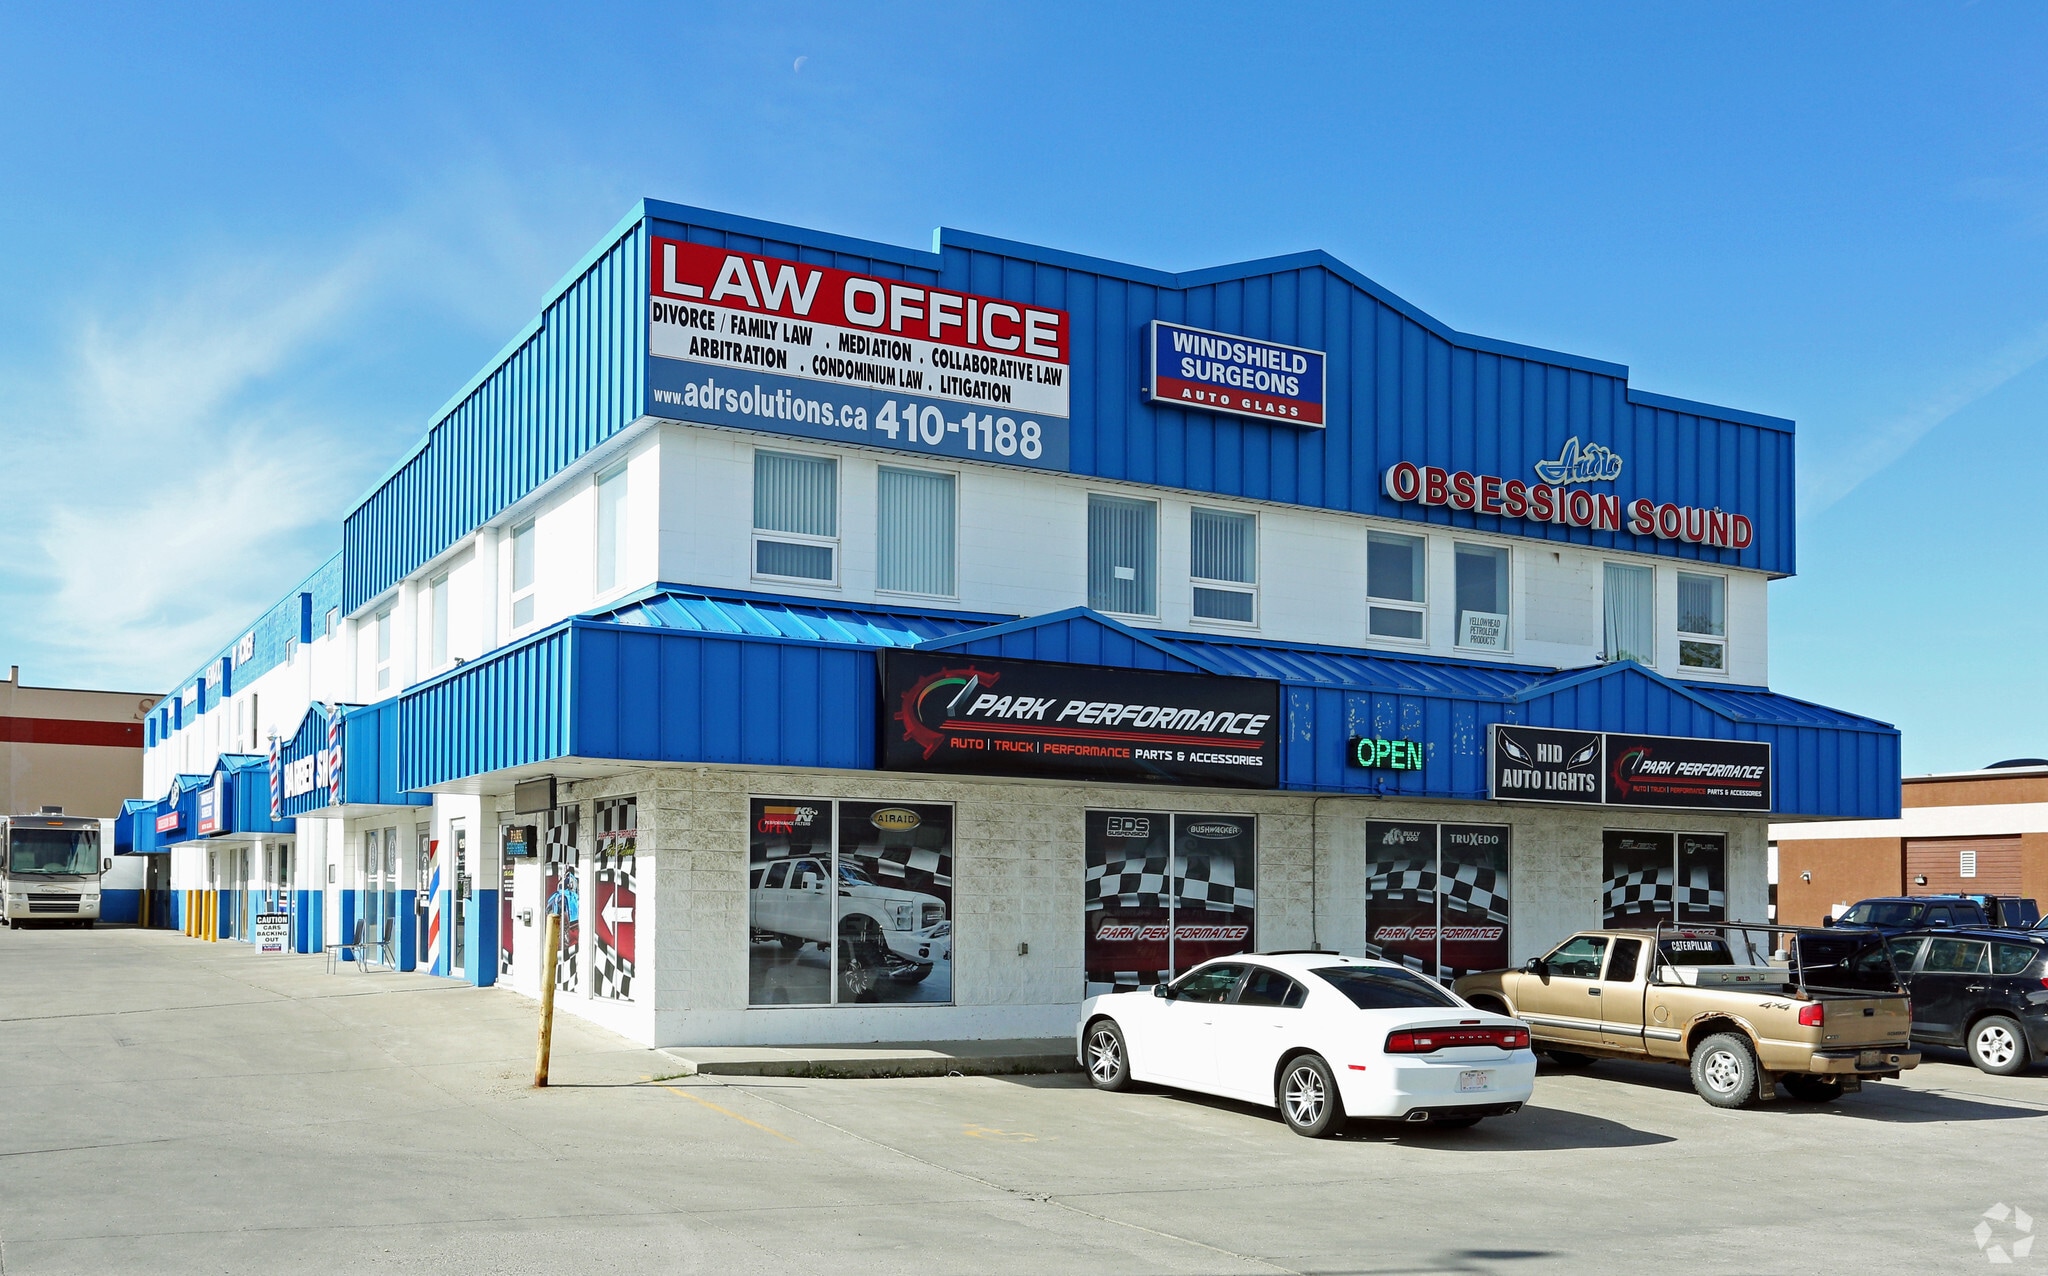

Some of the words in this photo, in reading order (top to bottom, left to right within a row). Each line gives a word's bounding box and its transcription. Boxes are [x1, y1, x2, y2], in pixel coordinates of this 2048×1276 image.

[663, 243, 823, 316] LAW
[843, 277, 1060, 359] OFFICE
[653, 302, 715, 331] DIVORCE
[731, 315, 778, 341] FAMILY
[784, 324, 813, 346] LAW
[839, 333, 912, 363] MEDIATION
[932, 348, 1033, 381] COLLABORATIVE
[1037, 365, 1062, 386] LAW
[1172, 331, 1307, 374] WINDSHIELD
[689, 336, 787, 369] ARBITRATION
[812, 355, 896, 386] CONDOMINIUM
[899, 368, 923, 391] LAW
[941, 375, 1011, 403] LITIGATION
[1181, 357, 1299, 396] SURGEONS
[1182, 388, 1230, 405] AUTO
[1241, 399, 1298, 416] GLASS
[653, 378, 867, 430] www.adrsolutions.ca
[875, 400, 1042, 460] 410-1188
[1386, 461, 1620, 531] OBSESSION
[1628, 498, 1753, 549] SOUND
[1469, 617, 1501, 627] YELLOWHEAD
[1470, 626, 1499, 636] PETROLEUM
[1470, 635, 1496, 645] PRODUCTS
[966, 694, 1057, 720] PARK
[1055, 700, 1270, 735] PERFORMANCE
[950, 738, 984, 749] AUTO
[994, 740, 1034, 752] TRUCK
[1043, 743, 1130, 758] PERFORMANCE
[1135, 749, 1173, 761] PARTS
[1177, 752, 1185, 761] &
[1189, 753, 1263, 766] ACCESSORIES
[1357, 738, 1422, 770] OPEN
[1536, 743, 1563, 763] HID
[284, 754, 314, 799] BARBER
[316, 745, 342, 789] SHP
[1639, 760, 1675, 774] PARK
[1675, 762, 1765, 779] PERFORMANCE
[1502, 768, 1541, 789] AUTO
[1545, 771, 1595, 792] LIGHTS
[1670, 787, 1706, 795] PERFORMANCE
[1707, 788, 1724, 796] PARTS
[1730, 789, 1762, 797] ACCESSORIES
[877, 814, 915, 823] AIRAID
[1107, 817, 1149, 831] BDS
[1190, 825, 1239, 834] BUSHWACKER
[1450, 833, 1499, 846] TRUXEDO
[257, 916, 287, 924] CAUTION
[1097, 926, 1139, 940] PARK
[1138, 926, 1248, 940] PERFORMANCE
[1374, 926, 1411, 940] PARK
[1410, 926, 1502, 940] PERFORMANCE
[1671, 941, 1713, 951] CATERPILLAR
